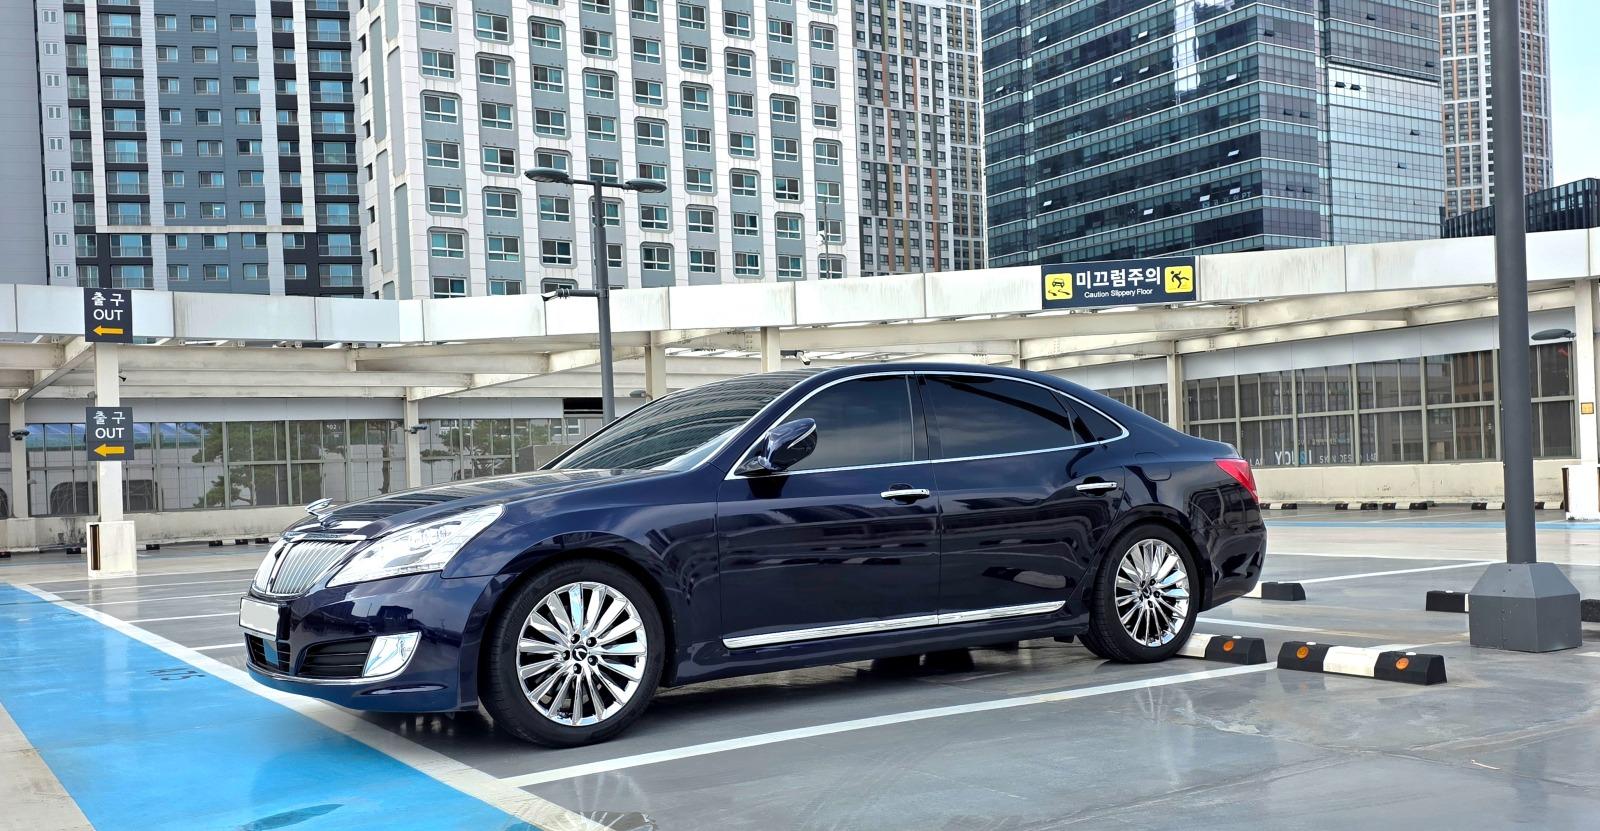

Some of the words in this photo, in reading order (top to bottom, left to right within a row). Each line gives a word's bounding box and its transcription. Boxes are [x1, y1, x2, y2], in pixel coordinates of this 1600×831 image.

[1076, 267, 1160, 289] 미끄럼주의
[1084, 290, 1109, 298] Caution
[1110, 289, 1136, 297] Slippery
[93, 309, 124, 321] OUT
[95, 427, 125, 439] OUT
